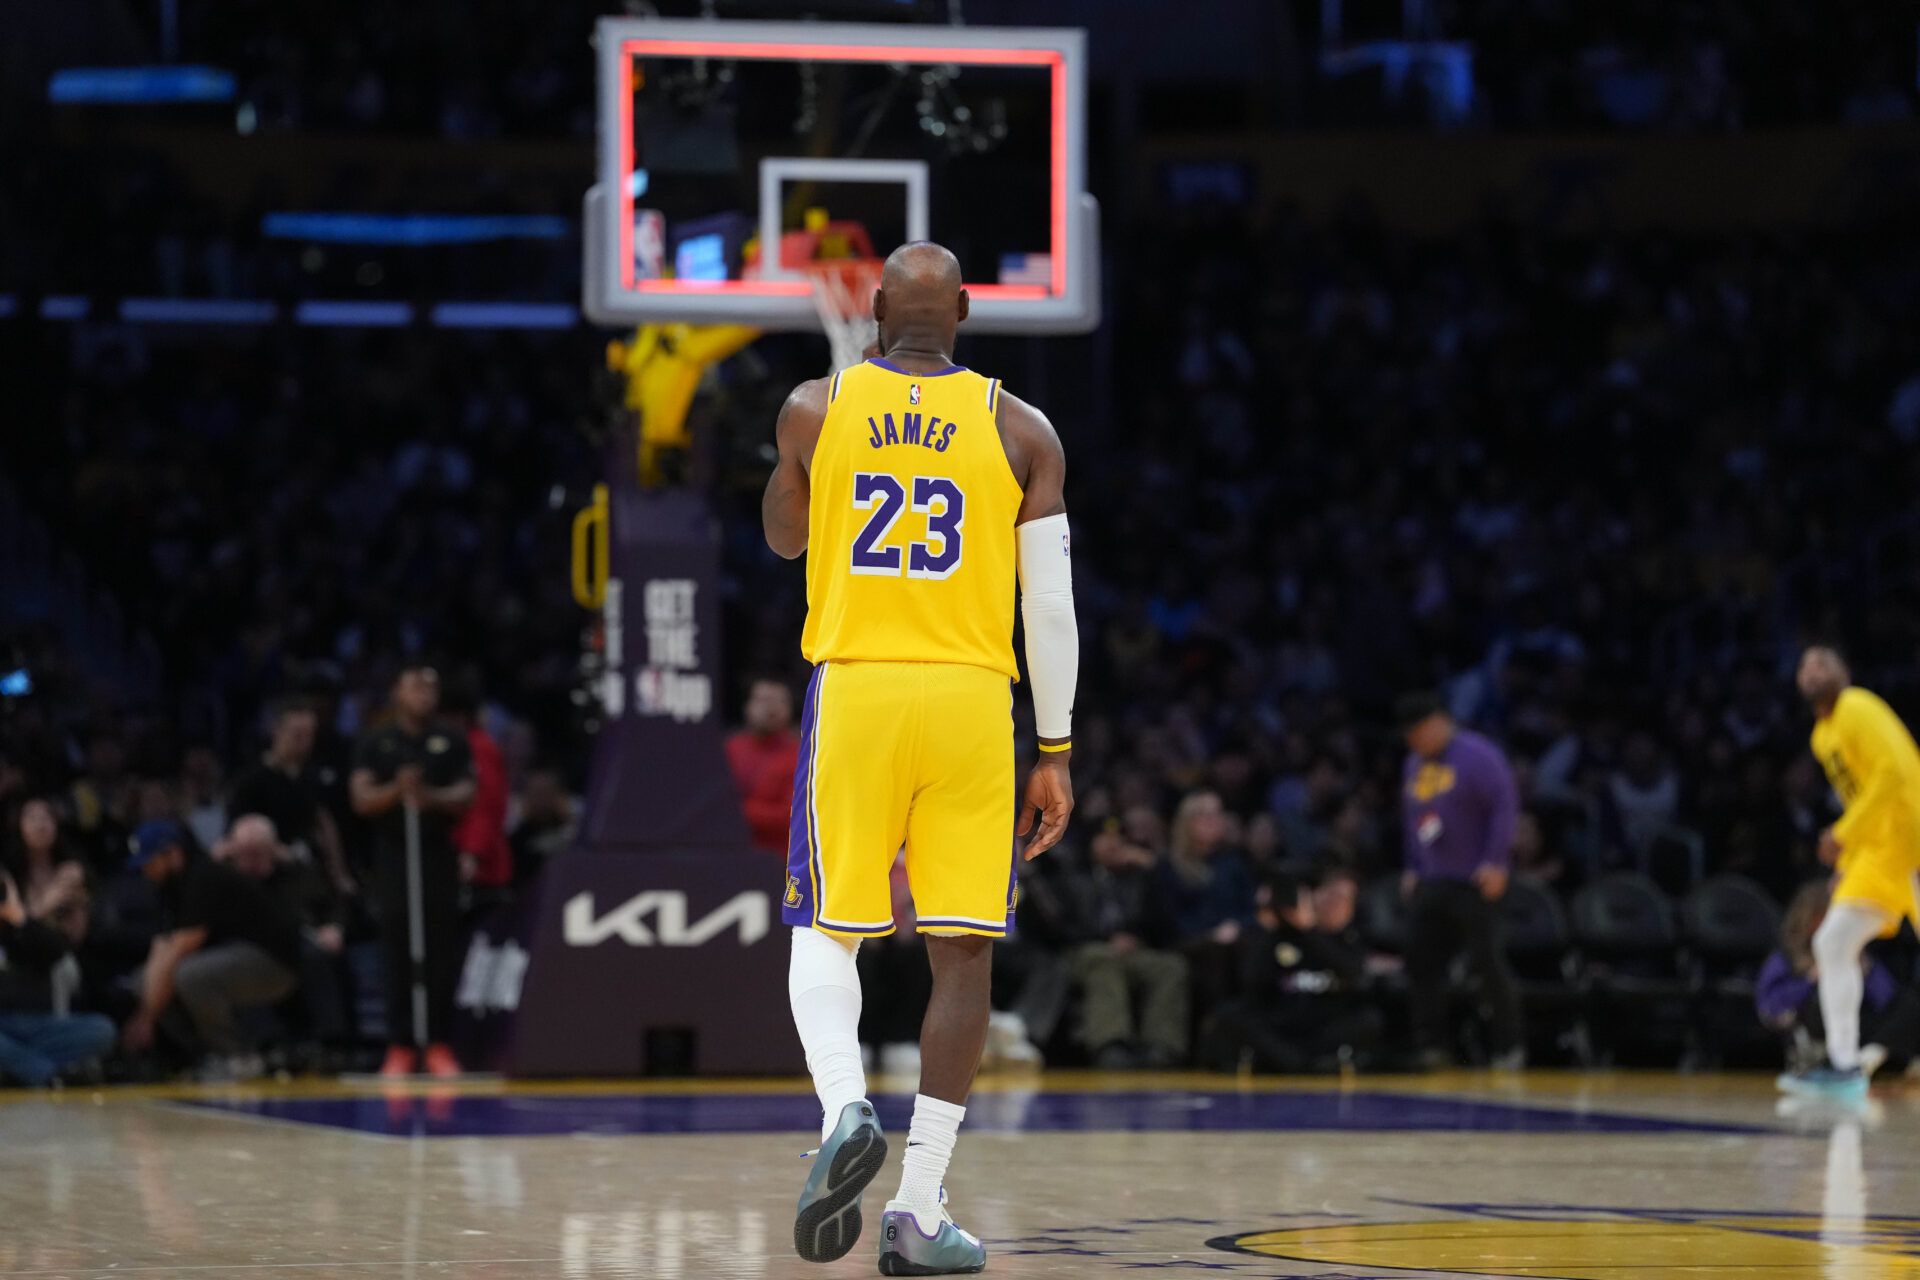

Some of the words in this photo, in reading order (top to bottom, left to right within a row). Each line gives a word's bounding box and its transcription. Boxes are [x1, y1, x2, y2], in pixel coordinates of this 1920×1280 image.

[868, 412, 957, 453] JAMES
[850, 471, 965, 581] 23
[563, 889, 770, 947] KIA
